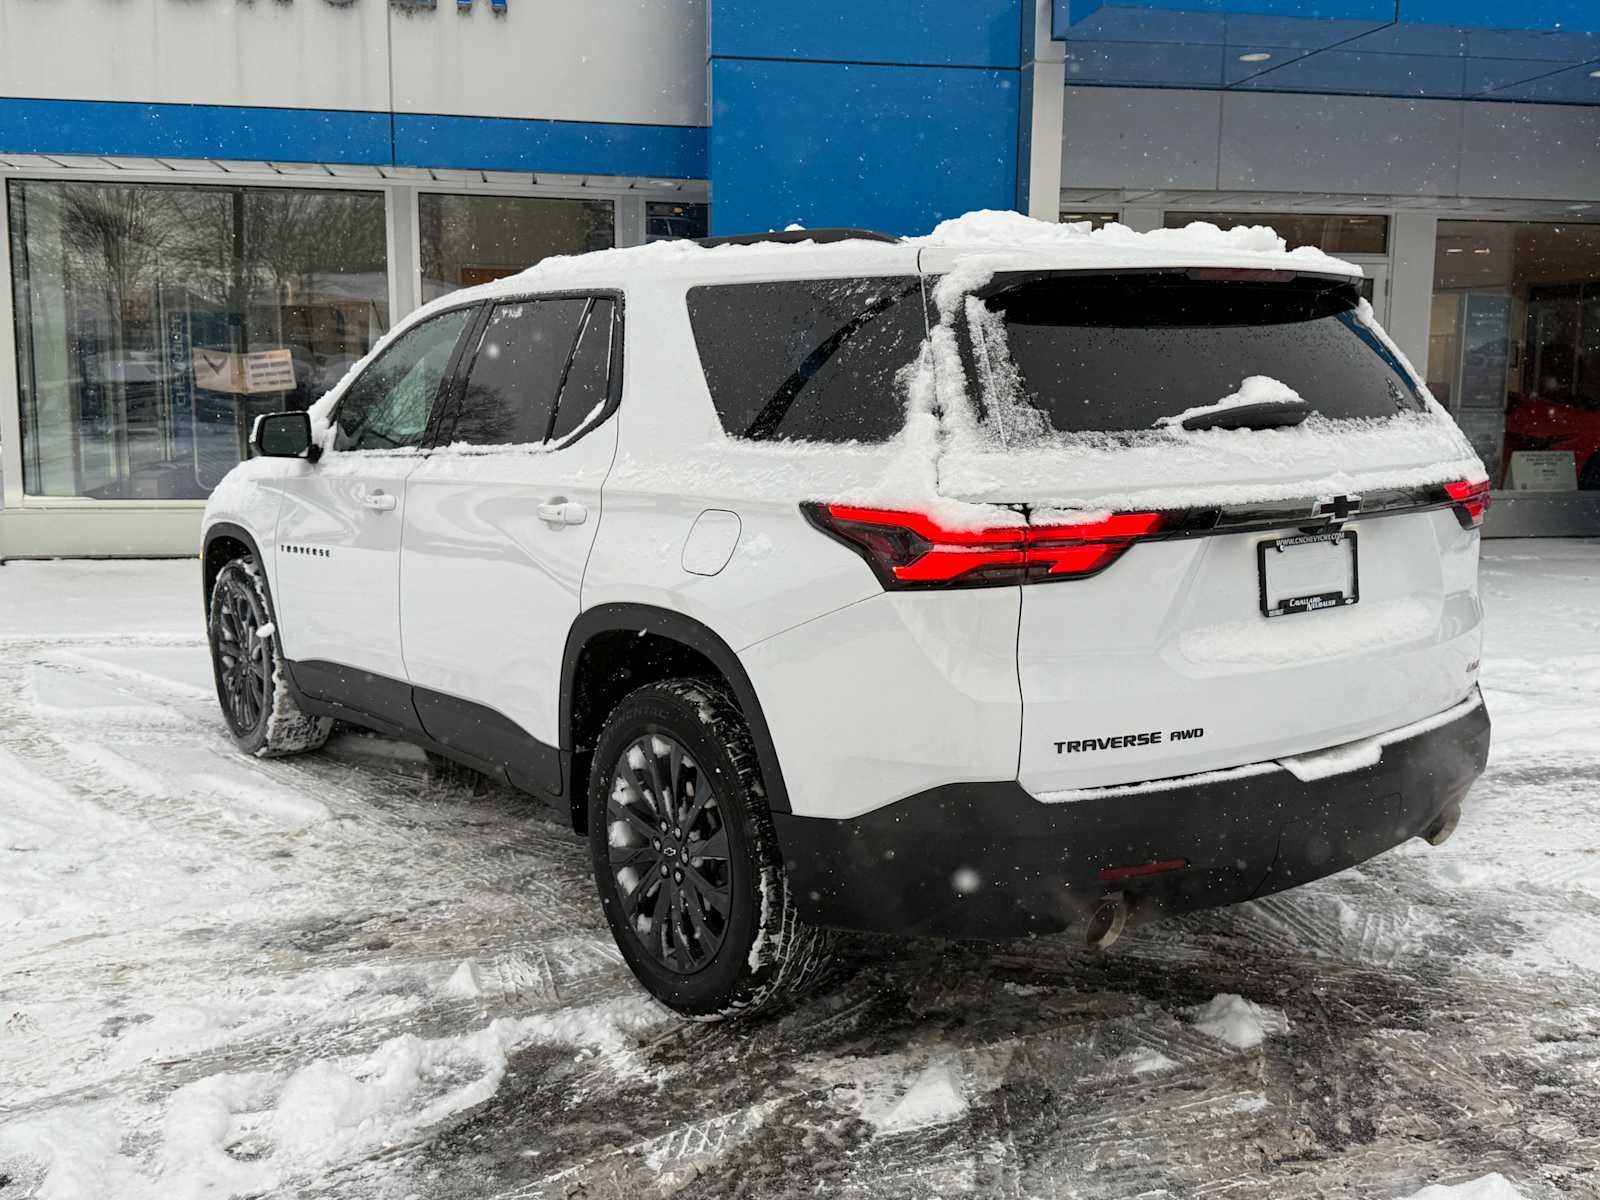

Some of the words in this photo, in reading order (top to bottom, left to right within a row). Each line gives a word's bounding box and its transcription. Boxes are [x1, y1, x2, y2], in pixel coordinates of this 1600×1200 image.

[281, 544, 331, 558] TRAVERSE
[1053, 731, 1162, 754] TRAVERSE
[1170, 728, 1204, 742] AWD
